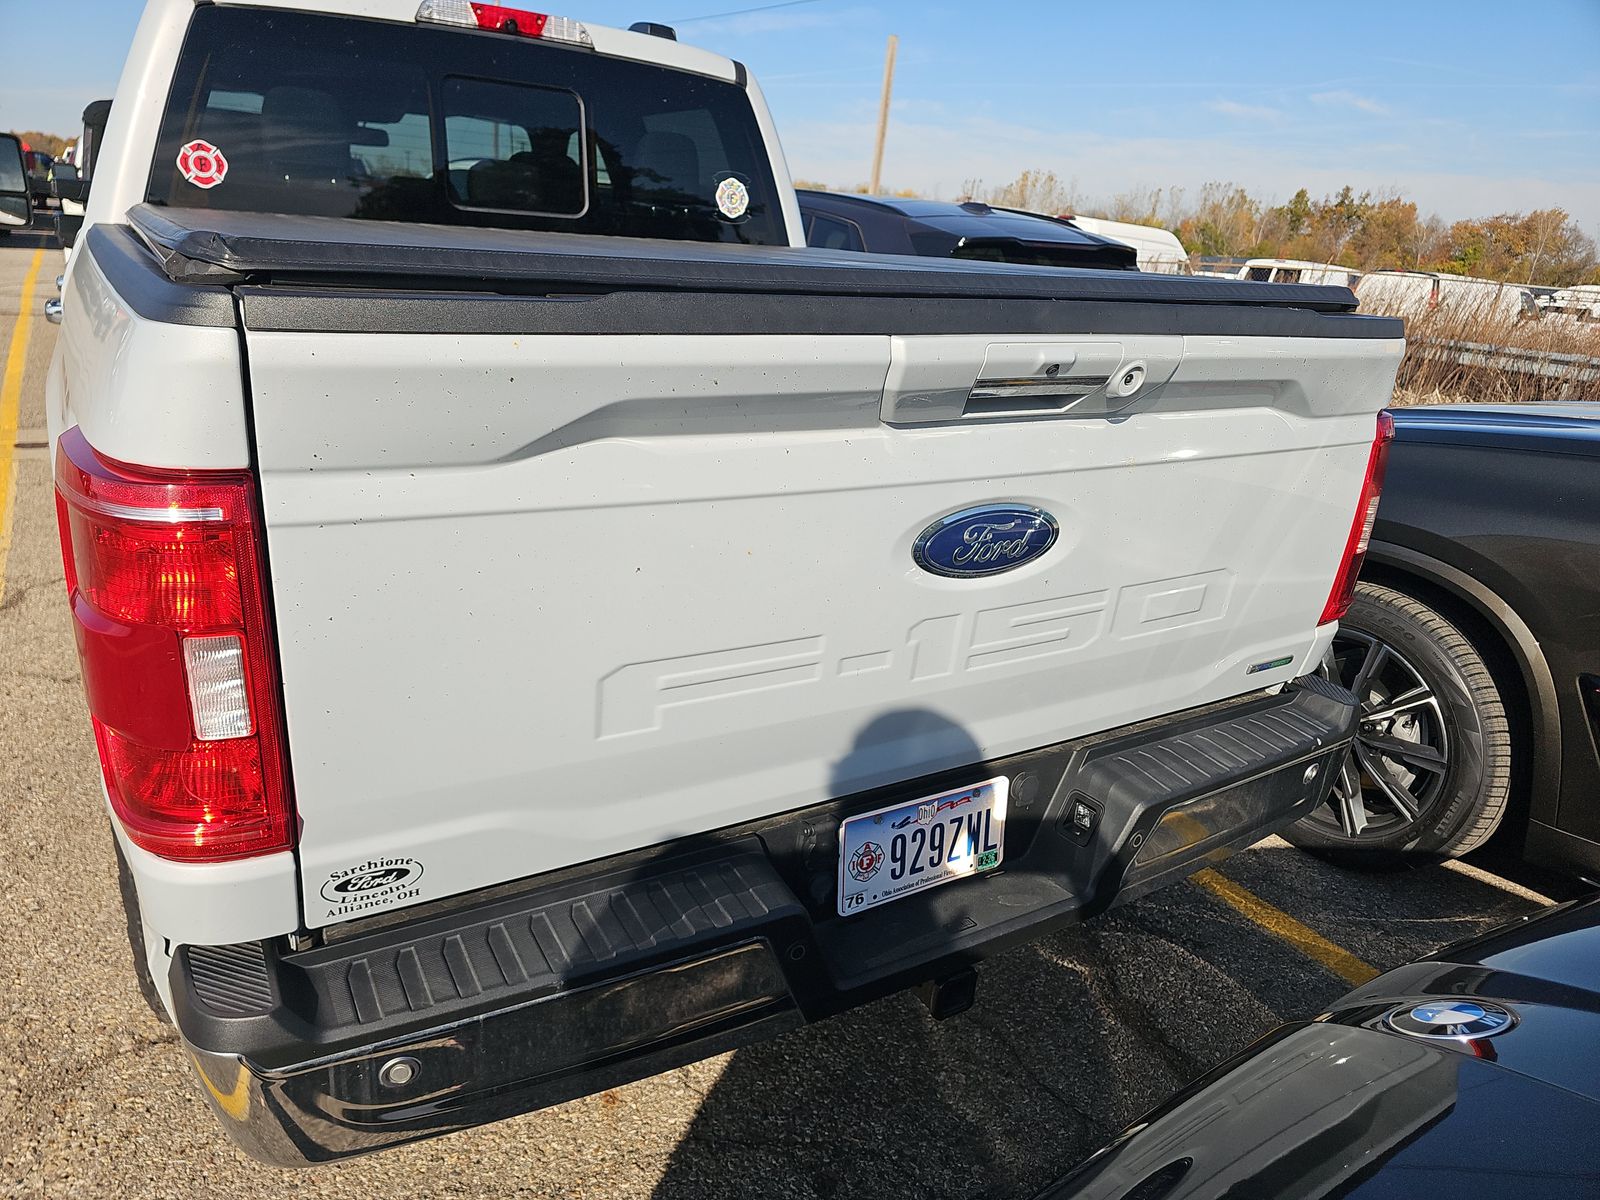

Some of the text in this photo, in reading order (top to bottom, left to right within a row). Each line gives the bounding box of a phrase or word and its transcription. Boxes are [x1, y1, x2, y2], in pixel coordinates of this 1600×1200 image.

[953, 520, 1035, 566] Ford
[596, 567, 1237, 741] F-150
[917, 803, 937, 822] Ohio
[890, 808, 998, 881] 929ZWL
[330, 857, 413, 882] Sarchione
[347, 870, 398, 891] Ford
[326, 887, 421, 918] Alliance, OH
[340, 883, 407, 904] Lincoln
[845, 892, 865, 909] 76
[893, 881, 915, 894] Association
[919, 872, 943, 885] Professional
